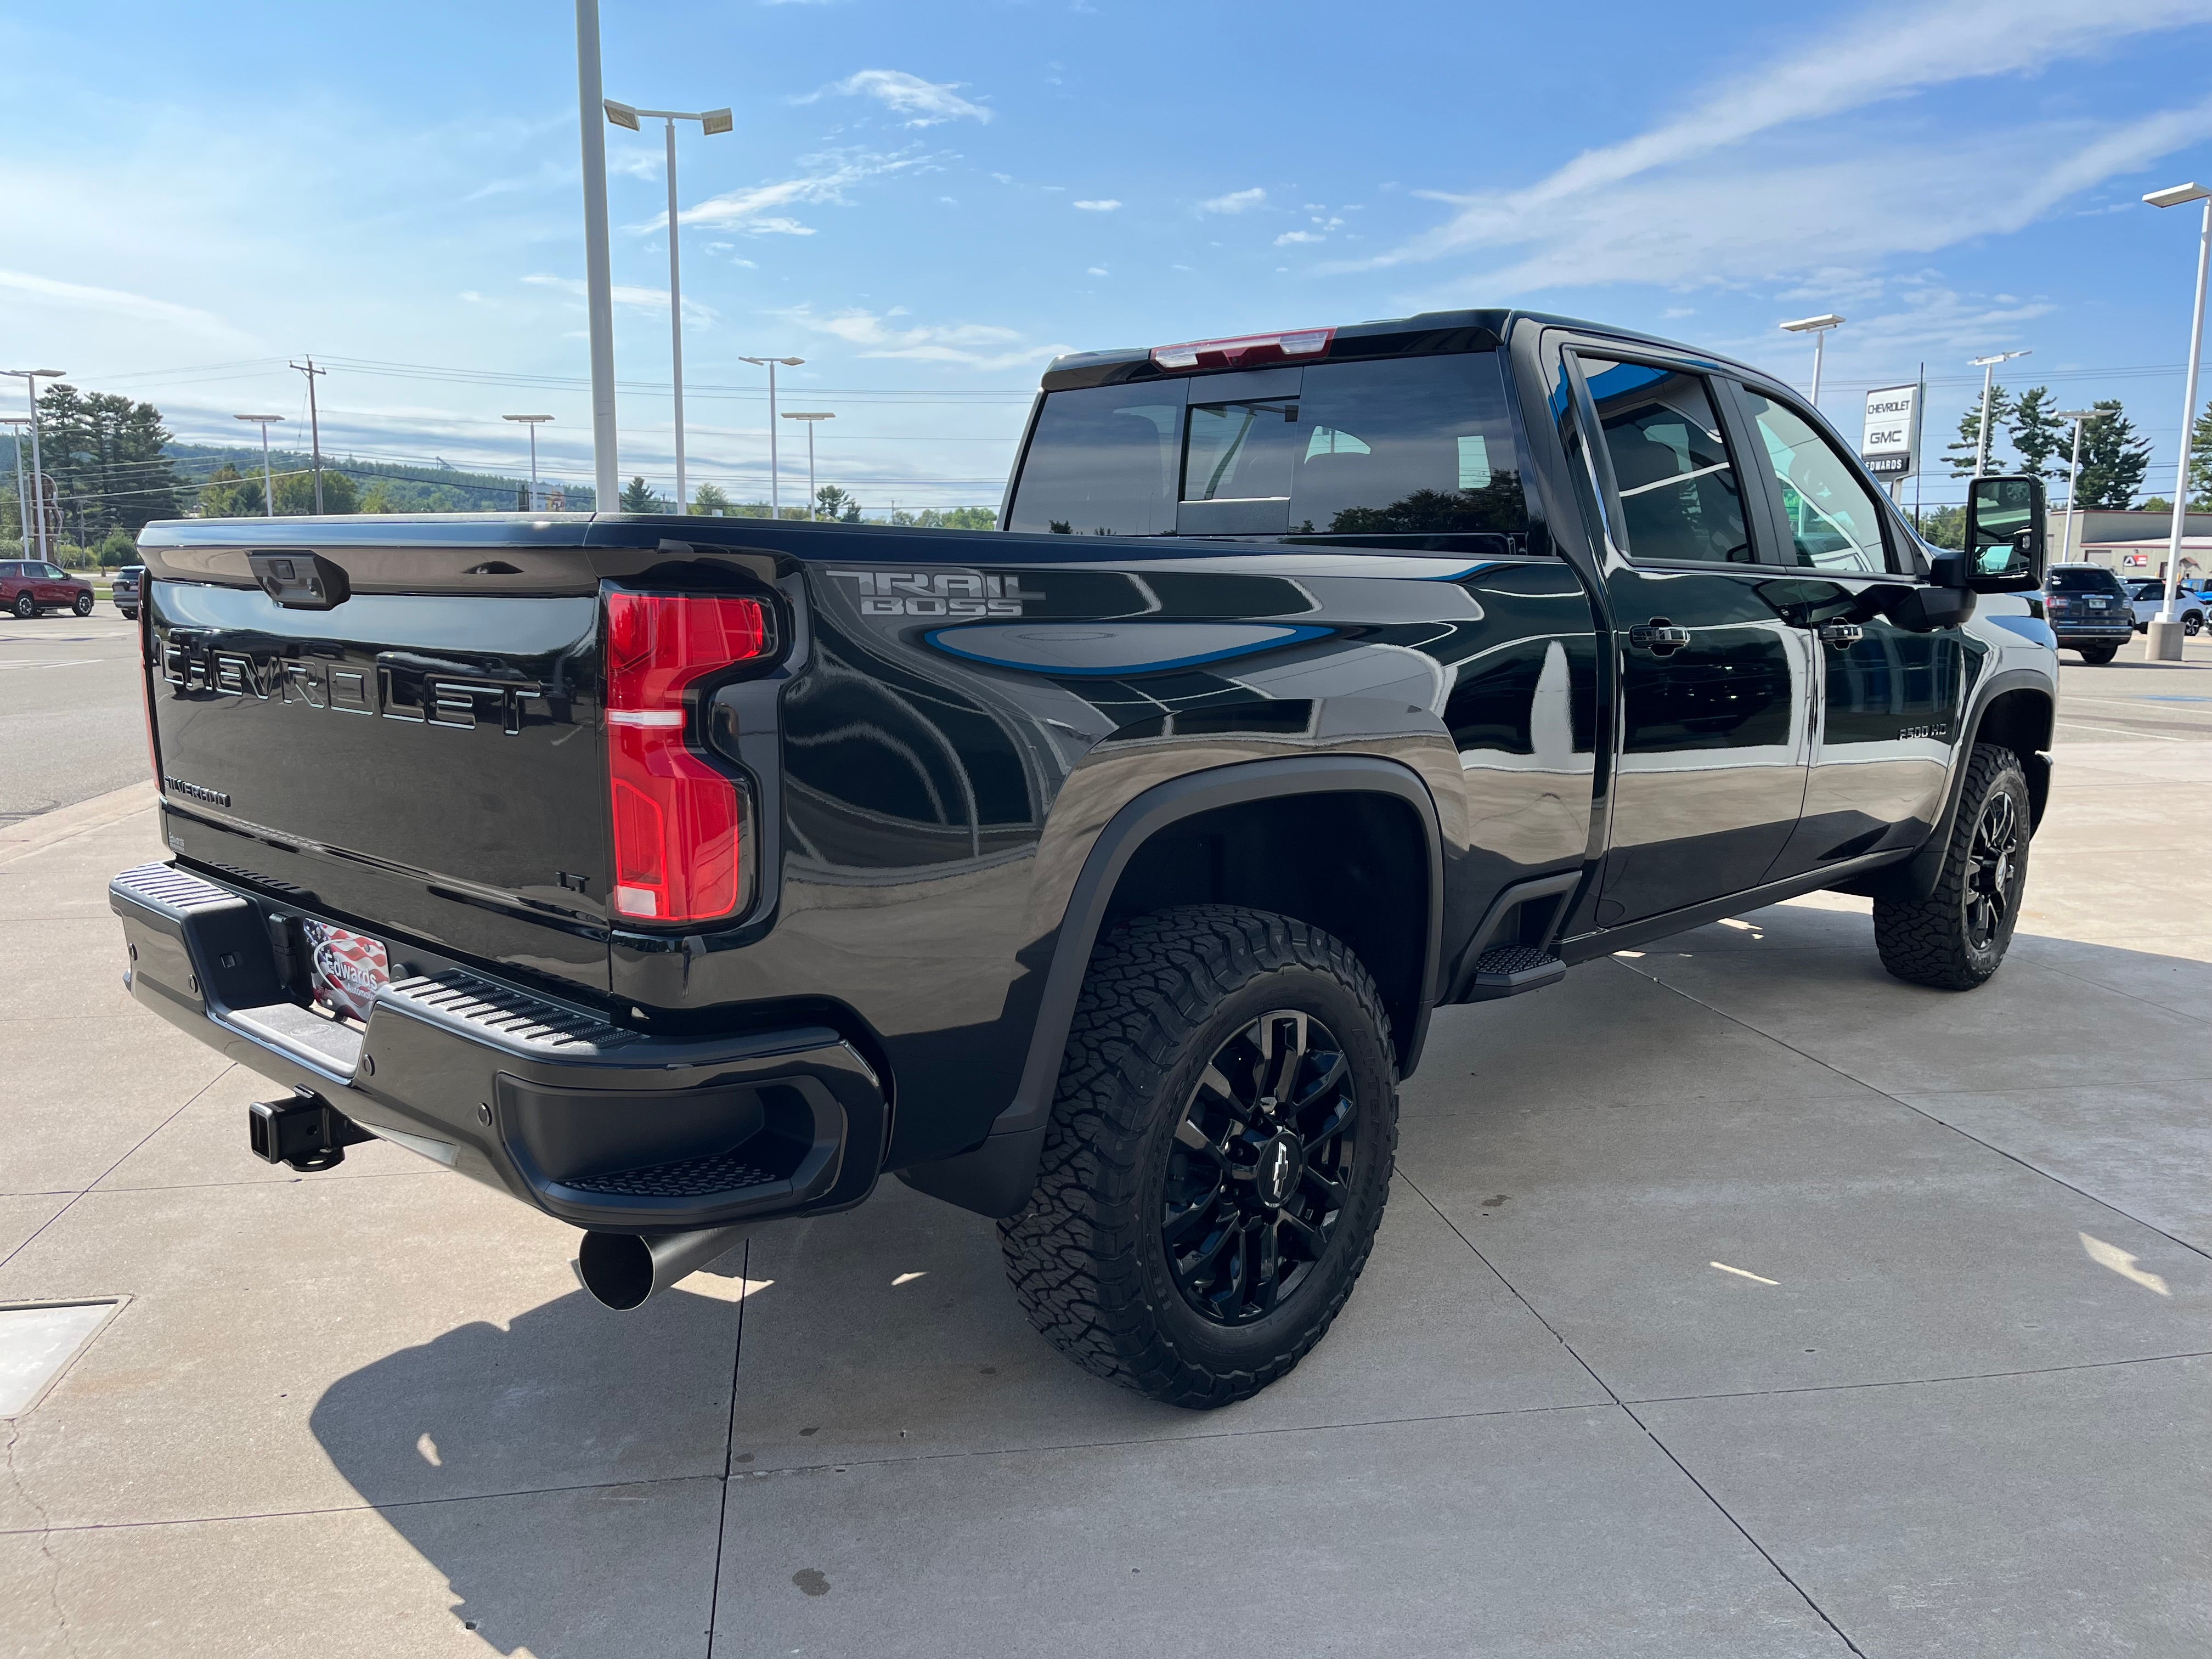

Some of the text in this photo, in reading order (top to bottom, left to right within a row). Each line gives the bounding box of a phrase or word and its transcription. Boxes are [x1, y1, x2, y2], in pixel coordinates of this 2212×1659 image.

[1868, 400, 1910, 415] CHEVROLET
[1870, 430, 1902, 444] GMC
[1865, 459, 1902, 471] EDWARDS
[826, 569, 1047, 600] TRAIL
[861, 596, 1023, 616] BOSS
[162, 640, 543, 736] CHEVROLET
[1897, 723, 1947, 741] 2500 HD
[164, 775, 232, 808] SILVERADO
[555, 871, 591, 894] LT
[325, 952, 378, 991] Edwards
[347, 983, 376, 1001] Automotiv
